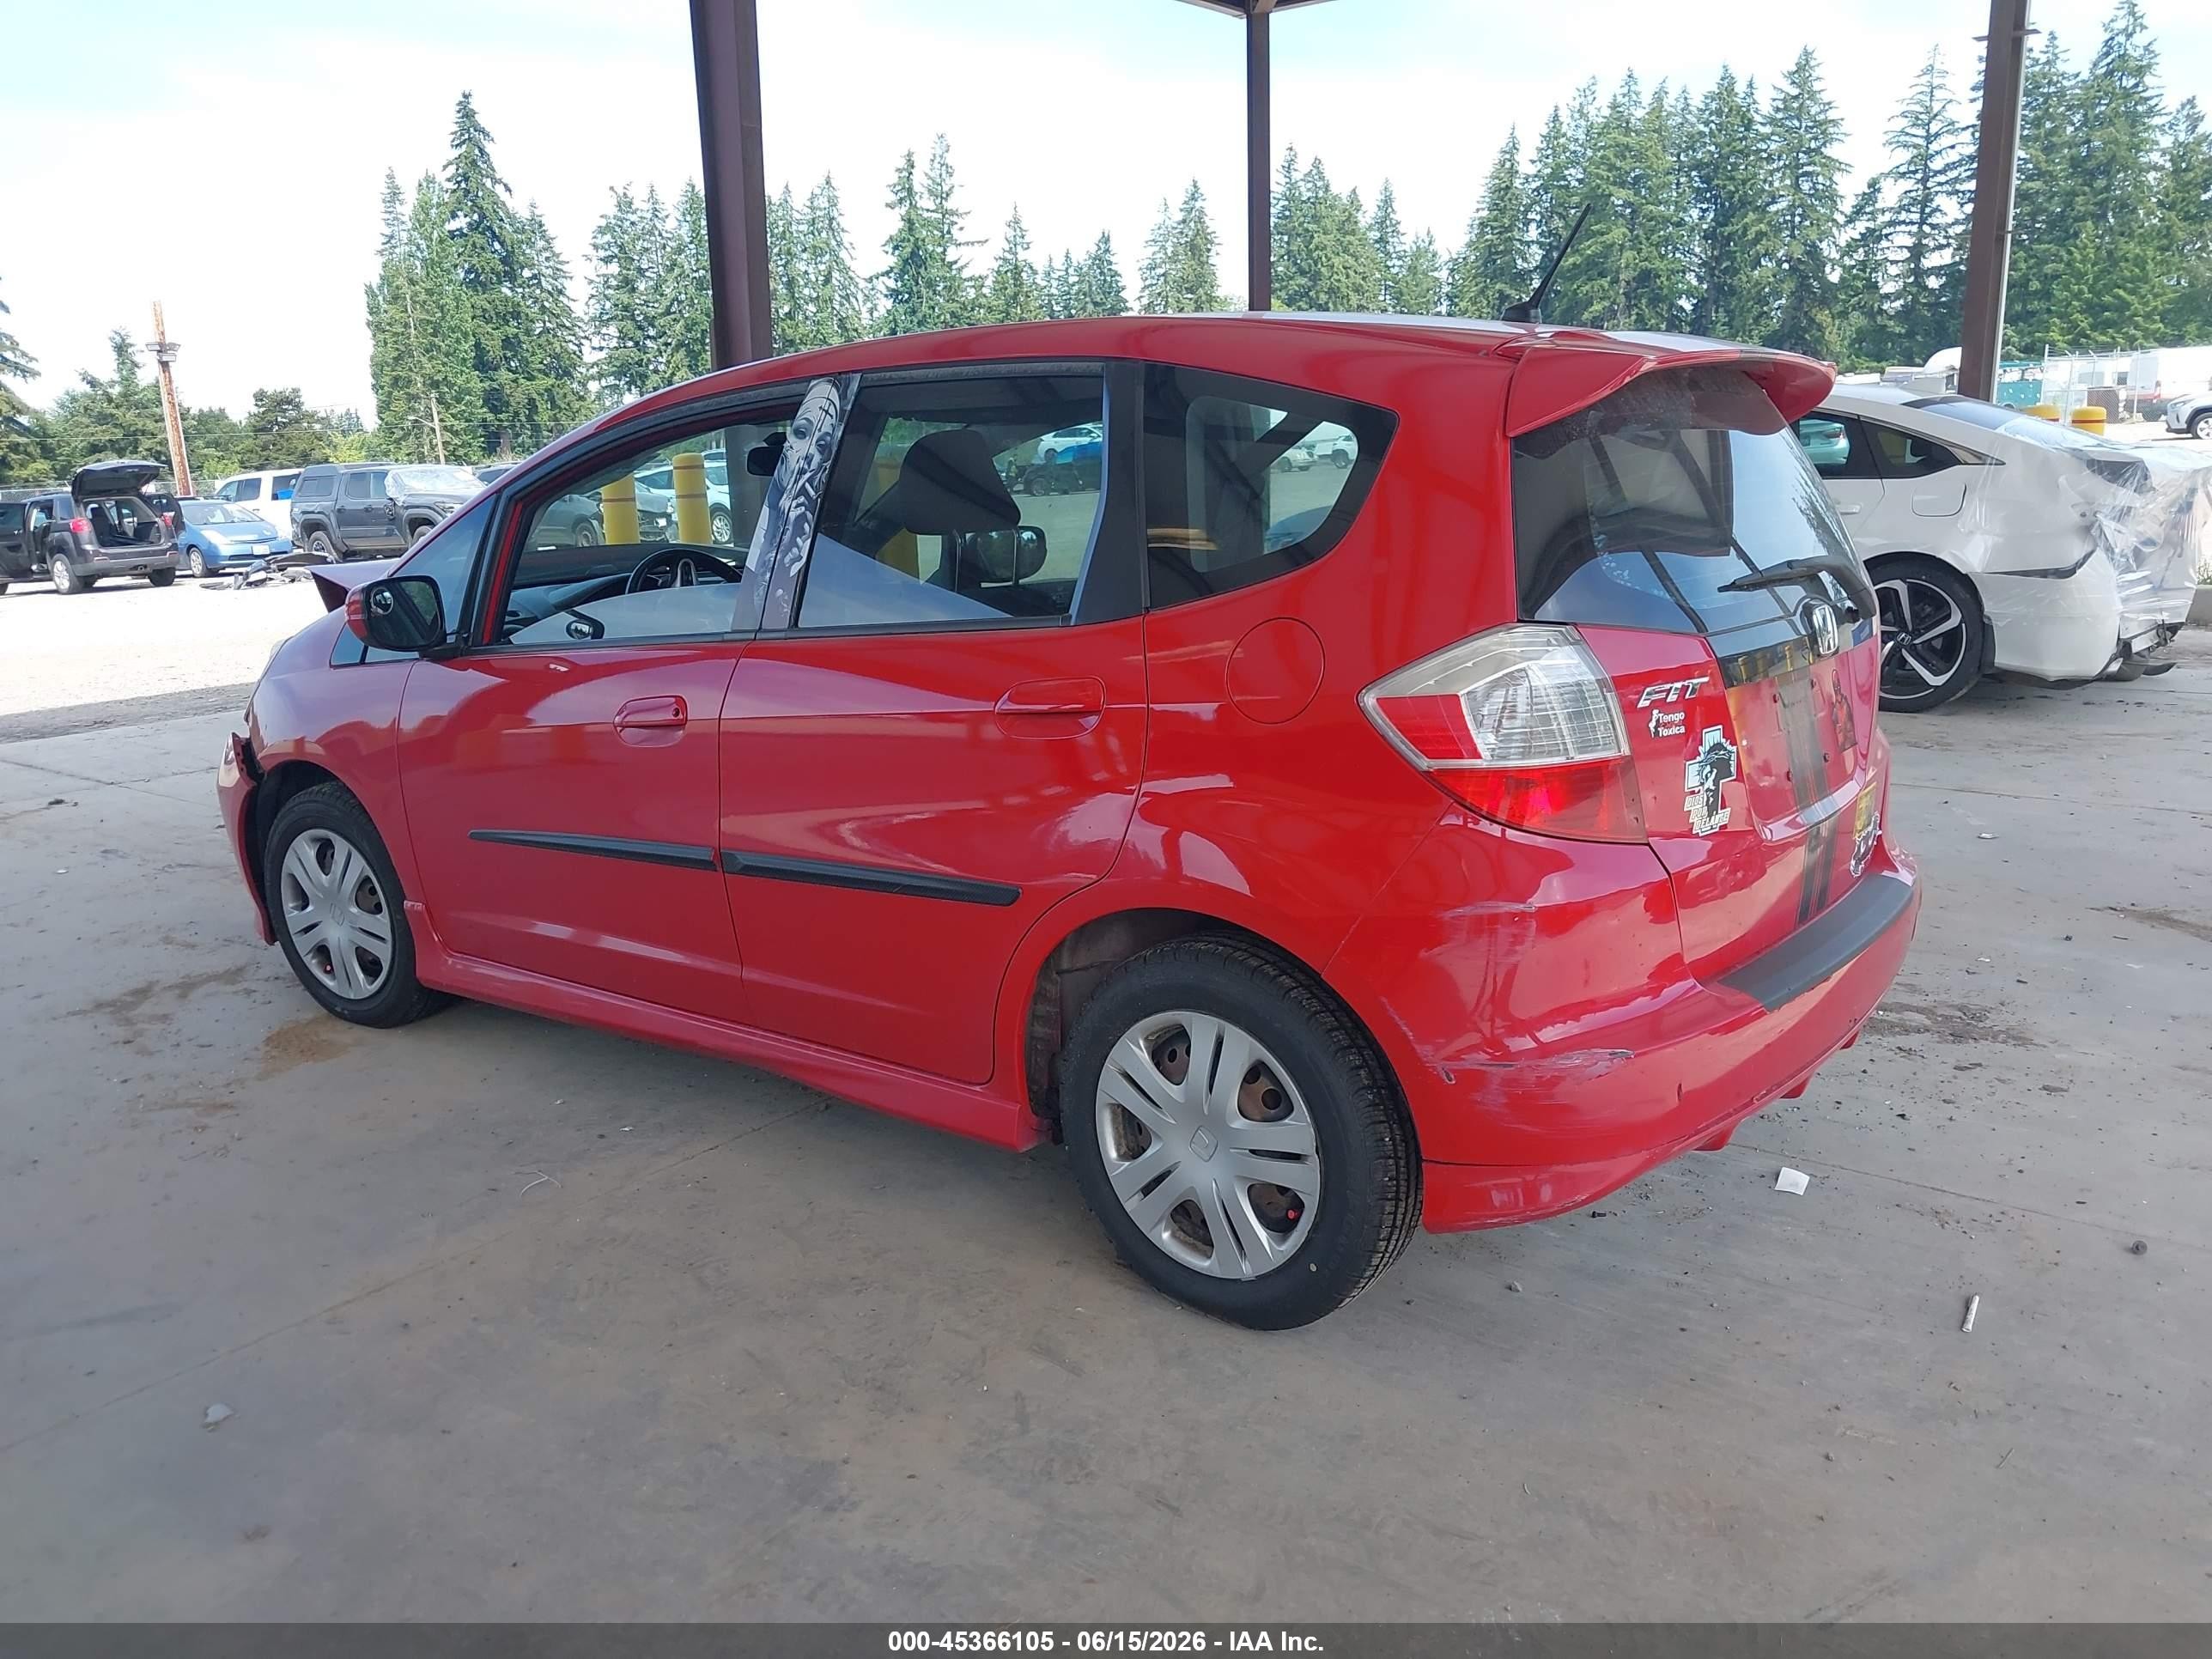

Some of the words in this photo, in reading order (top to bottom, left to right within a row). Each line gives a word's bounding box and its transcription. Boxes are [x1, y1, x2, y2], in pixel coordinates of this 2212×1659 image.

[1637, 677, 1710, 708] FIT
[1657, 712, 1686, 723] Tengo
[1657, 726, 1686, 737] Toxica
[1686, 795, 1704, 807] DIOS
[1692, 806, 1709, 819] POR
